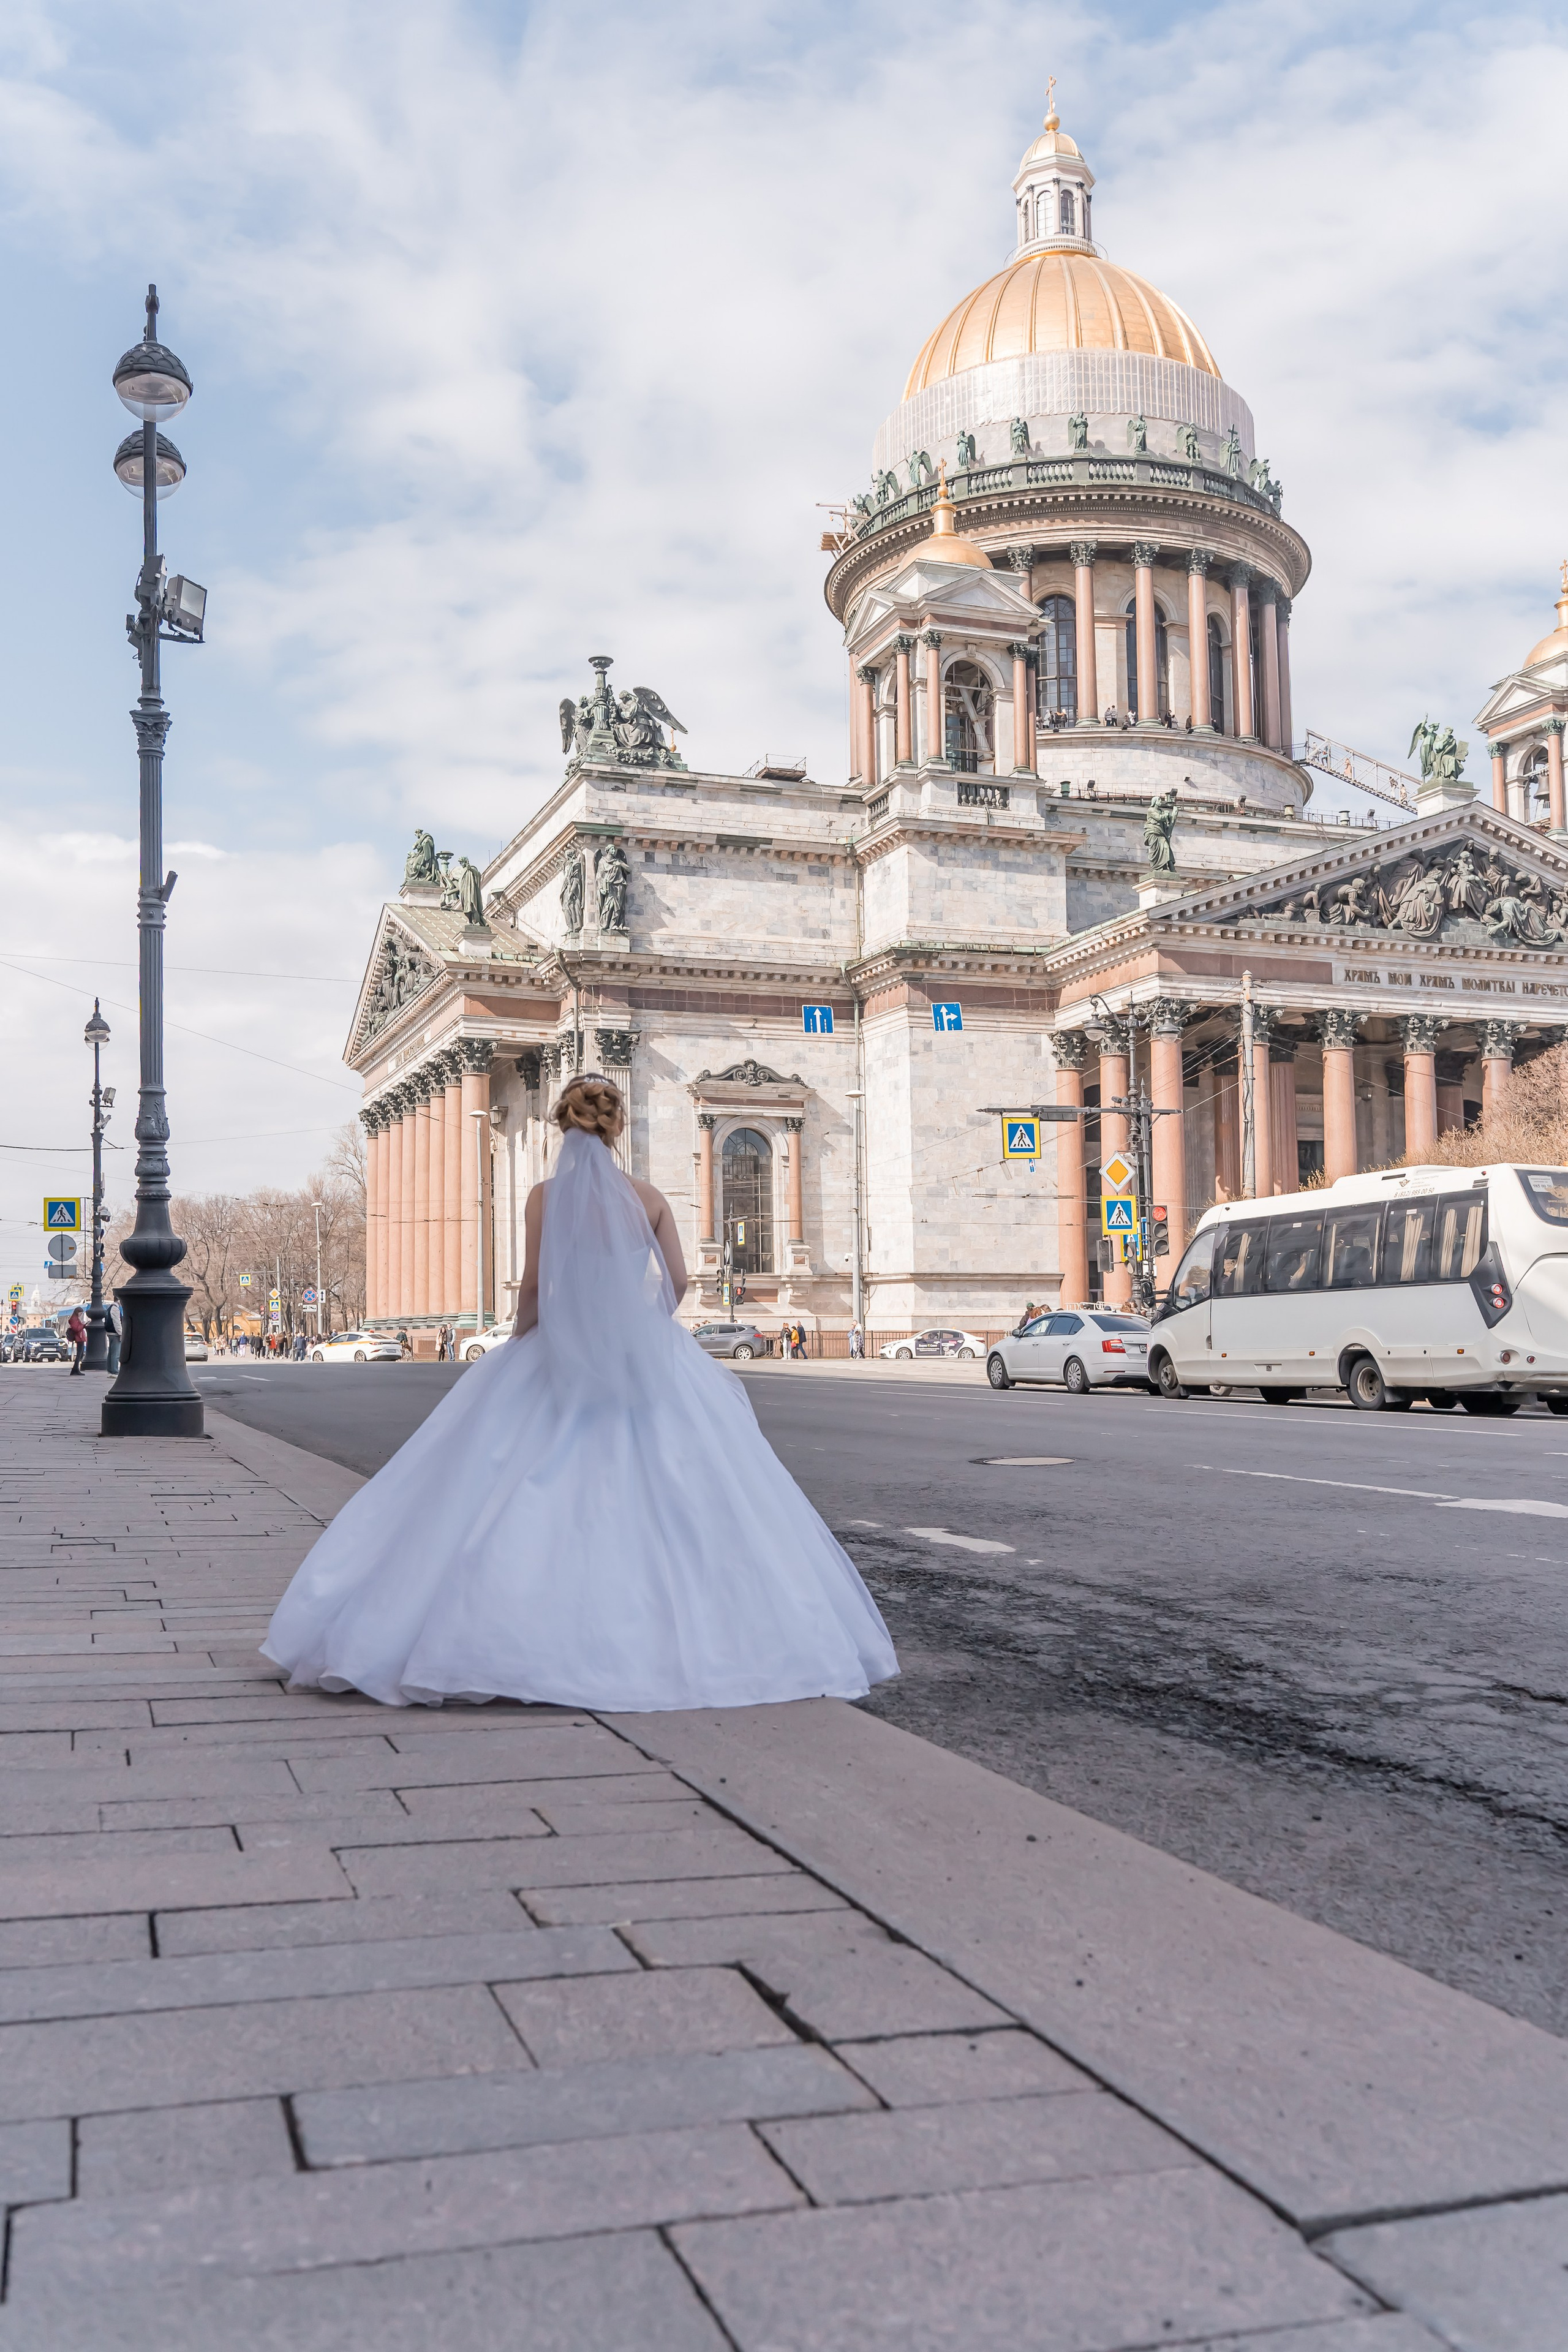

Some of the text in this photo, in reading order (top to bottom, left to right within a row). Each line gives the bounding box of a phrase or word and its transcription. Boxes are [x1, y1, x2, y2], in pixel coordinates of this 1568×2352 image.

[1344, 970, 1381, 984] ХРАМЪ
[1420, 974, 1455, 989] ХРАМЪ
[1462, 978, 1515, 993] МОЛИТВЫ
